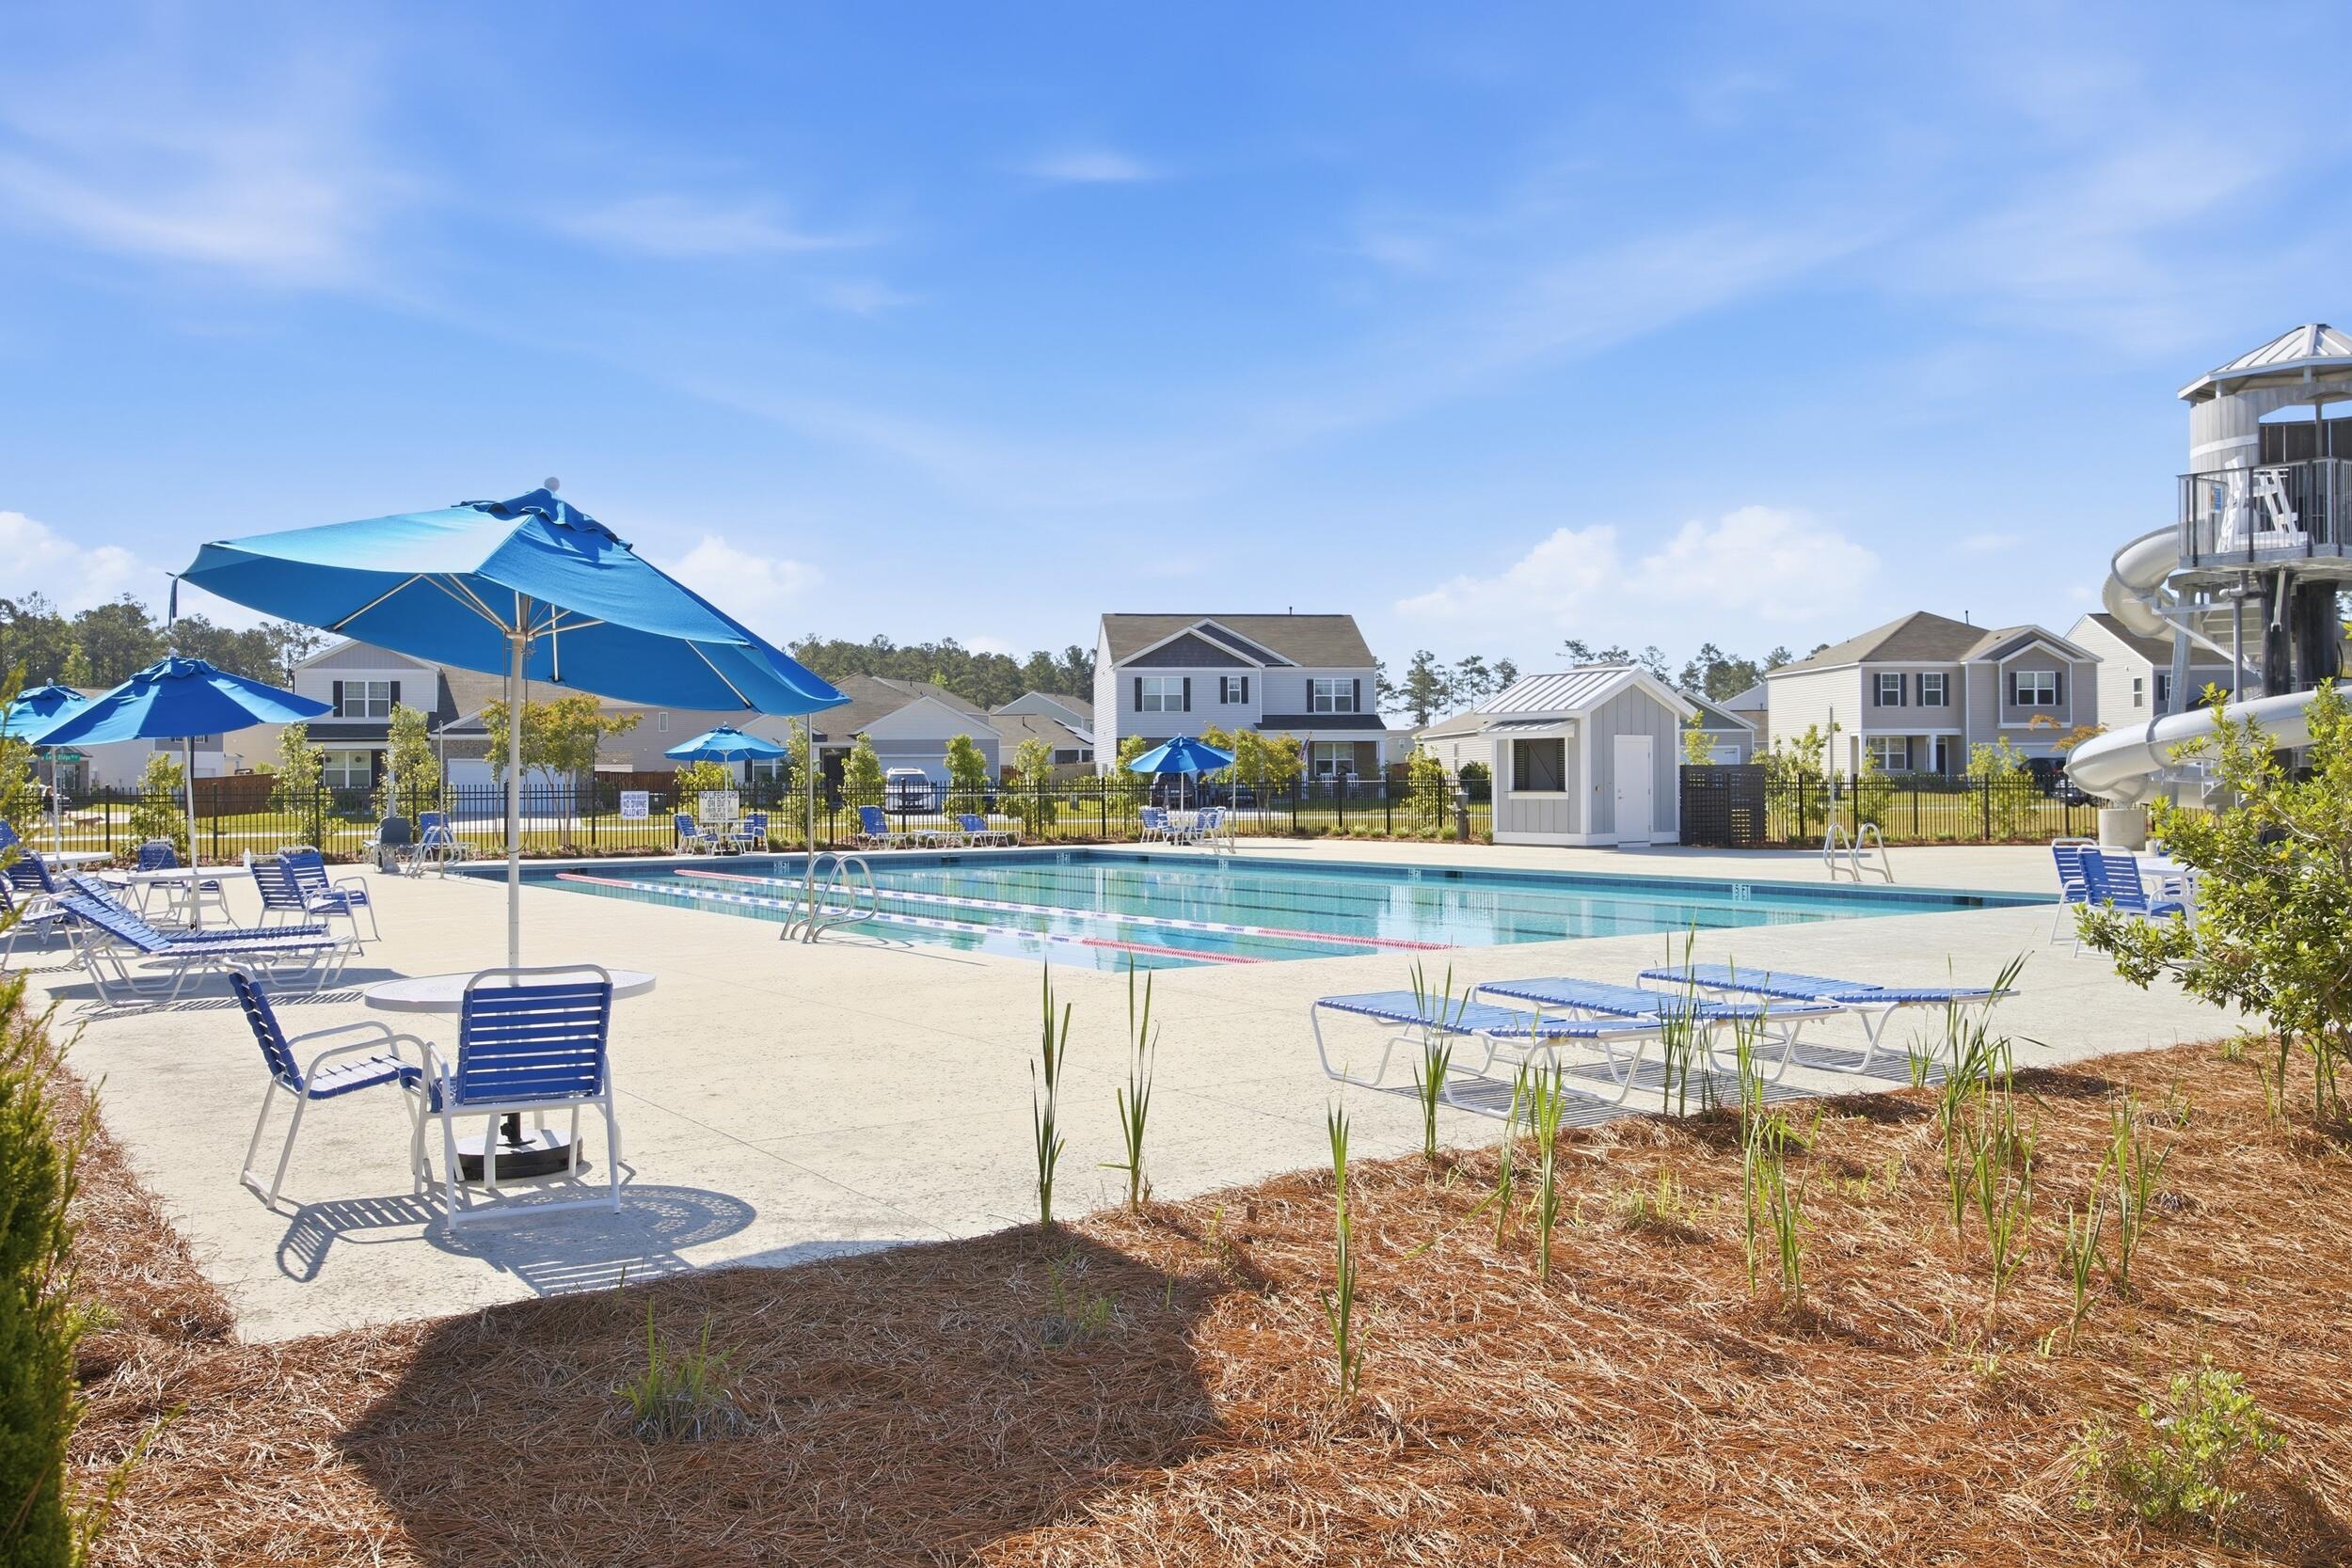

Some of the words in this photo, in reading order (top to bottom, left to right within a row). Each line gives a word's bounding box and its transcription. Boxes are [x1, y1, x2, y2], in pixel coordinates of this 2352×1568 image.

[699, 791, 707, 800] NO
[708, 791, 739, 800] LIFEGARD
[623, 800, 629, 808] NO
[630, 800, 647, 808] DIVING
[623, 808, 646, 816] ALLOWED
